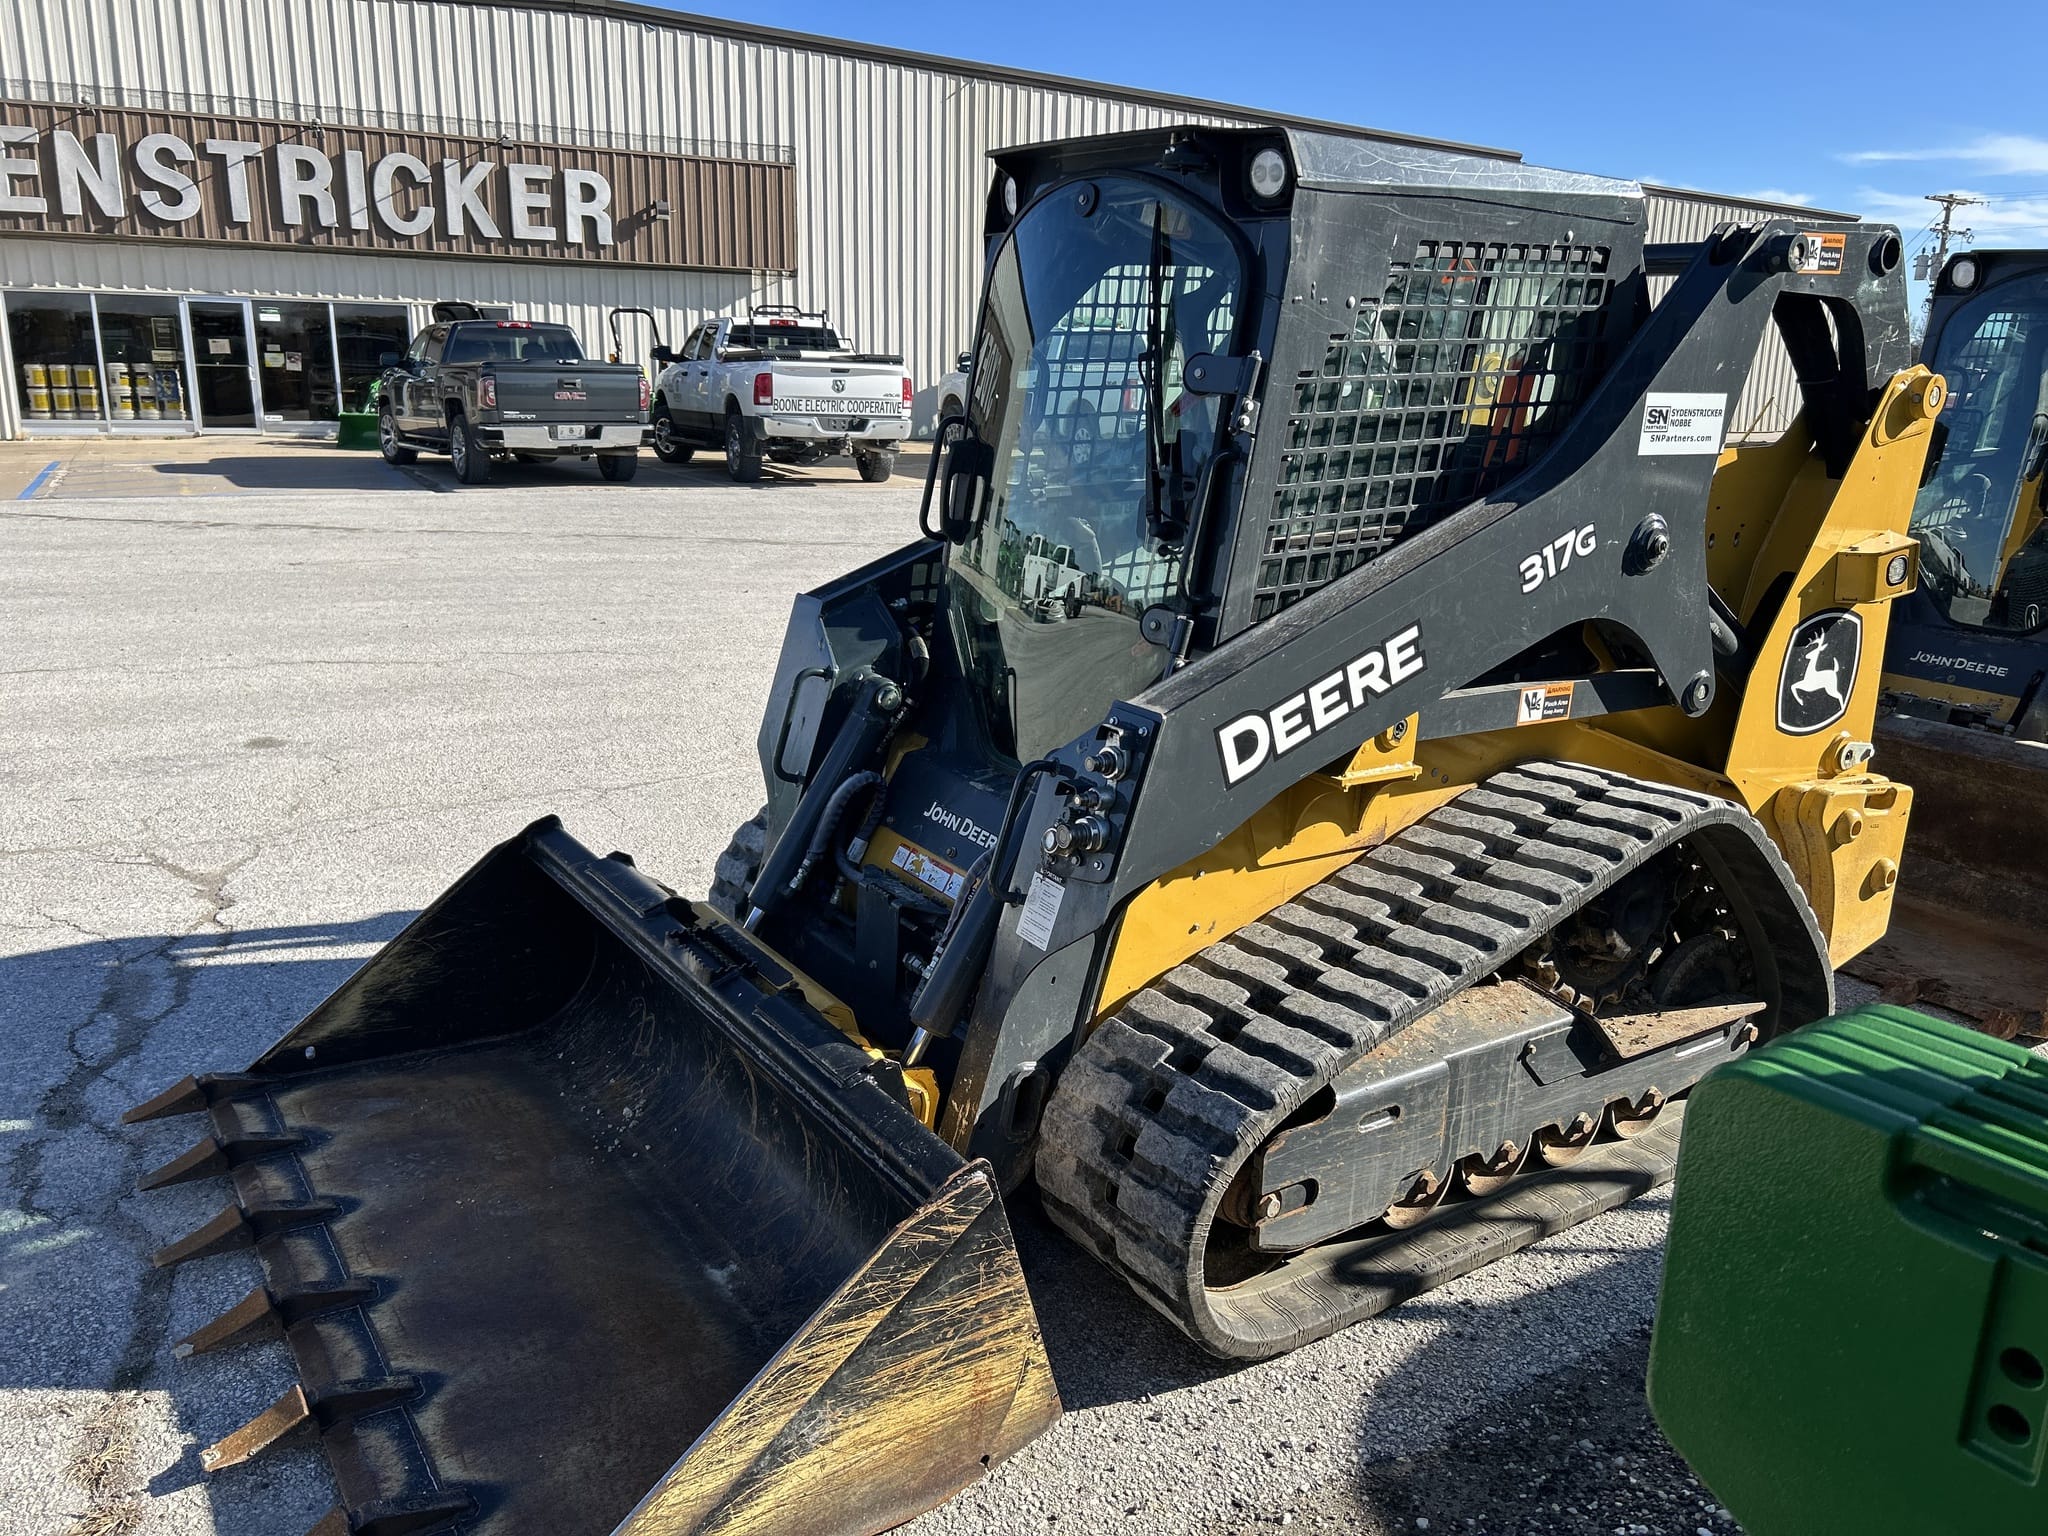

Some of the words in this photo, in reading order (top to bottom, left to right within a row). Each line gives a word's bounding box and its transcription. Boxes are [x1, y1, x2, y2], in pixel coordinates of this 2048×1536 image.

[554, 391, 587, 400] GMC
[773, 398, 802, 412] BOONE
[805, 399, 844, 413] ELECTRIC
[847, 401, 902, 414] COOPERATIVE
[1671, 408, 1723, 417] SYDENSTRICKER
[1646, 408, 1669, 425] SN
[1670, 418, 1692, 428] NOBBE
[1649, 434, 1712, 442] SNPartners.com
[1519, 522, 1597, 594] 317G
[1910, 650, 1953, 668] JOHN
[1953, 657, 2009, 677] DEERE
[1217, 622, 1427, 787] DEERE
[923, 801, 961, 832] JOHN
[959, 817, 999, 849] DEER
